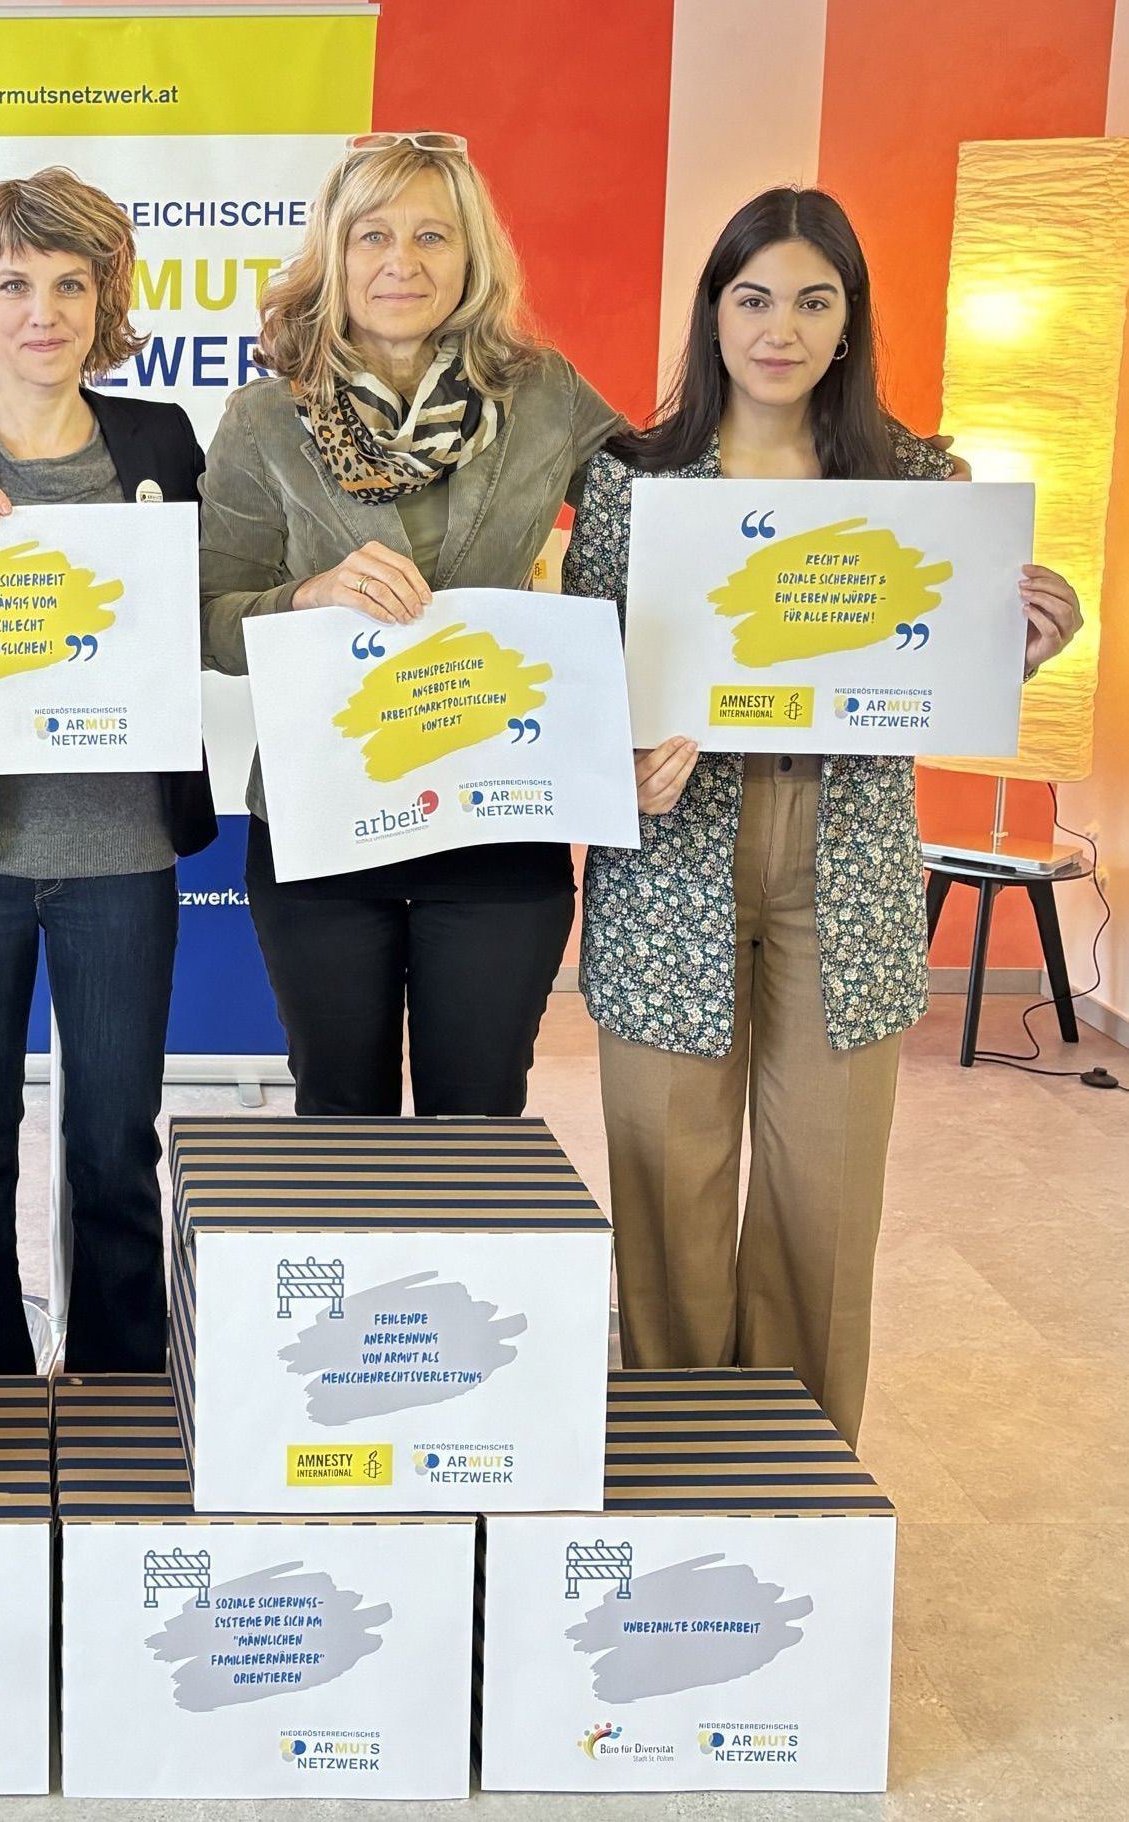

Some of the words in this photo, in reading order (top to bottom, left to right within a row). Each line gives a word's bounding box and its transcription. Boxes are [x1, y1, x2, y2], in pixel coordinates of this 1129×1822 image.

[806, 555, 839, 566] RECHT
[842, 555, 860, 566] AUF
[0, 573, 66, 588] SICHERHEIT
[777, 573, 817, 585] SOZIALE
[819, 574, 877, 585] SICHERHEIT
[32, 597, 58, 609] VOM
[775, 592, 792, 603] EIN
[794, 592, 827, 604] LEBEN
[830, 592, 840, 604] IN
[842, 591, 878, 604] WÜRDE
[784, 609, 801, 622] FÜR
[803, 611, 829, 623] ALLE
[395, 658, 484, 683] FRAUENSPEZIFISCHE
[412, 680, 458, 698] ANGEBOTE
[459, 679, 471, 690] IM
[835, 688, 932, 696] NIEDERÖSTERREICHISCHES
[381, 694, 507, 722] ARBEITSMARKTPOLITISCHEN
[720, 695, 775, 708] AMNESTY
[866, 700, 931, 712] ARMUTS
[719, 710, 774, 719] INTERNATIONAL
[66, 718, 128, 730] ARMUTS
[422, 715, 463, 733] KONTEXT
[849, 715, 930, 728] NETZWERK
[51, 734, 128, 745] NETZWERK
[459, 780, 553, 790] NIEDERÖSTERREICHISCHES
[490, 790, 553, 802] ARMUTS
[476, 804, 554, 817] NETZWERK
[374, 1313, 428, 1326] FEHLENDE
[364, 1332, 438, 1346] ANERKENNUNG
[362, 1351, 382, 1365] VON
[384, 1351, 419, 1364] ARMUT
[422, 1351, 440, 1363] ALS
[322, 1370, 483, 1385] MENSCHENRECHTSVERLETZUNG
[297, 1454, 353, 1467] AMNESTY
[447, 1455, 514, 1468] ARMUTS
[297, 1469, 353, 1478] INTERNATIONAL
[430, 1471, 513, 1483] NETZWERK
[215, 1597, 256, 1609] SOZIALE
[258, 1597, 324, 1609] SICHERUNGS-
[215, 1616, 262, 1628] SYSTEME
[264, 1615, 281, 1627] DIE
[284, 1615, 304, 1628] SICH
[306, 1616, 323, 1627] AM
[623, 1620, 688, 1634] UNBEZAHLTE
[691, 1621, 761, 1634] SORGEARBEIT
[233, 1633, 303, 1647] "MÄNNLICHEN
[211, 1651, 325, 1666] FAMILIENERNÄHERER"
[233, 1671, 302, 1684] ORIENTIEREN
[280, 1730, 381, 1738] NIEDERÖSTERREICHISCHES
[732, 1734, 798, 1747] ARMUTS
[313, 1742, 380, 1754] ARMUTS
[600, 1744, 619, 1753] Büro
[622, 1745, 632, 1753] für
[635, 1744, 674, 1753] Diversität
[715, 1750, 797, 1762] NETZWERK
[298, 1757, 380, 1770] NETZWERK
